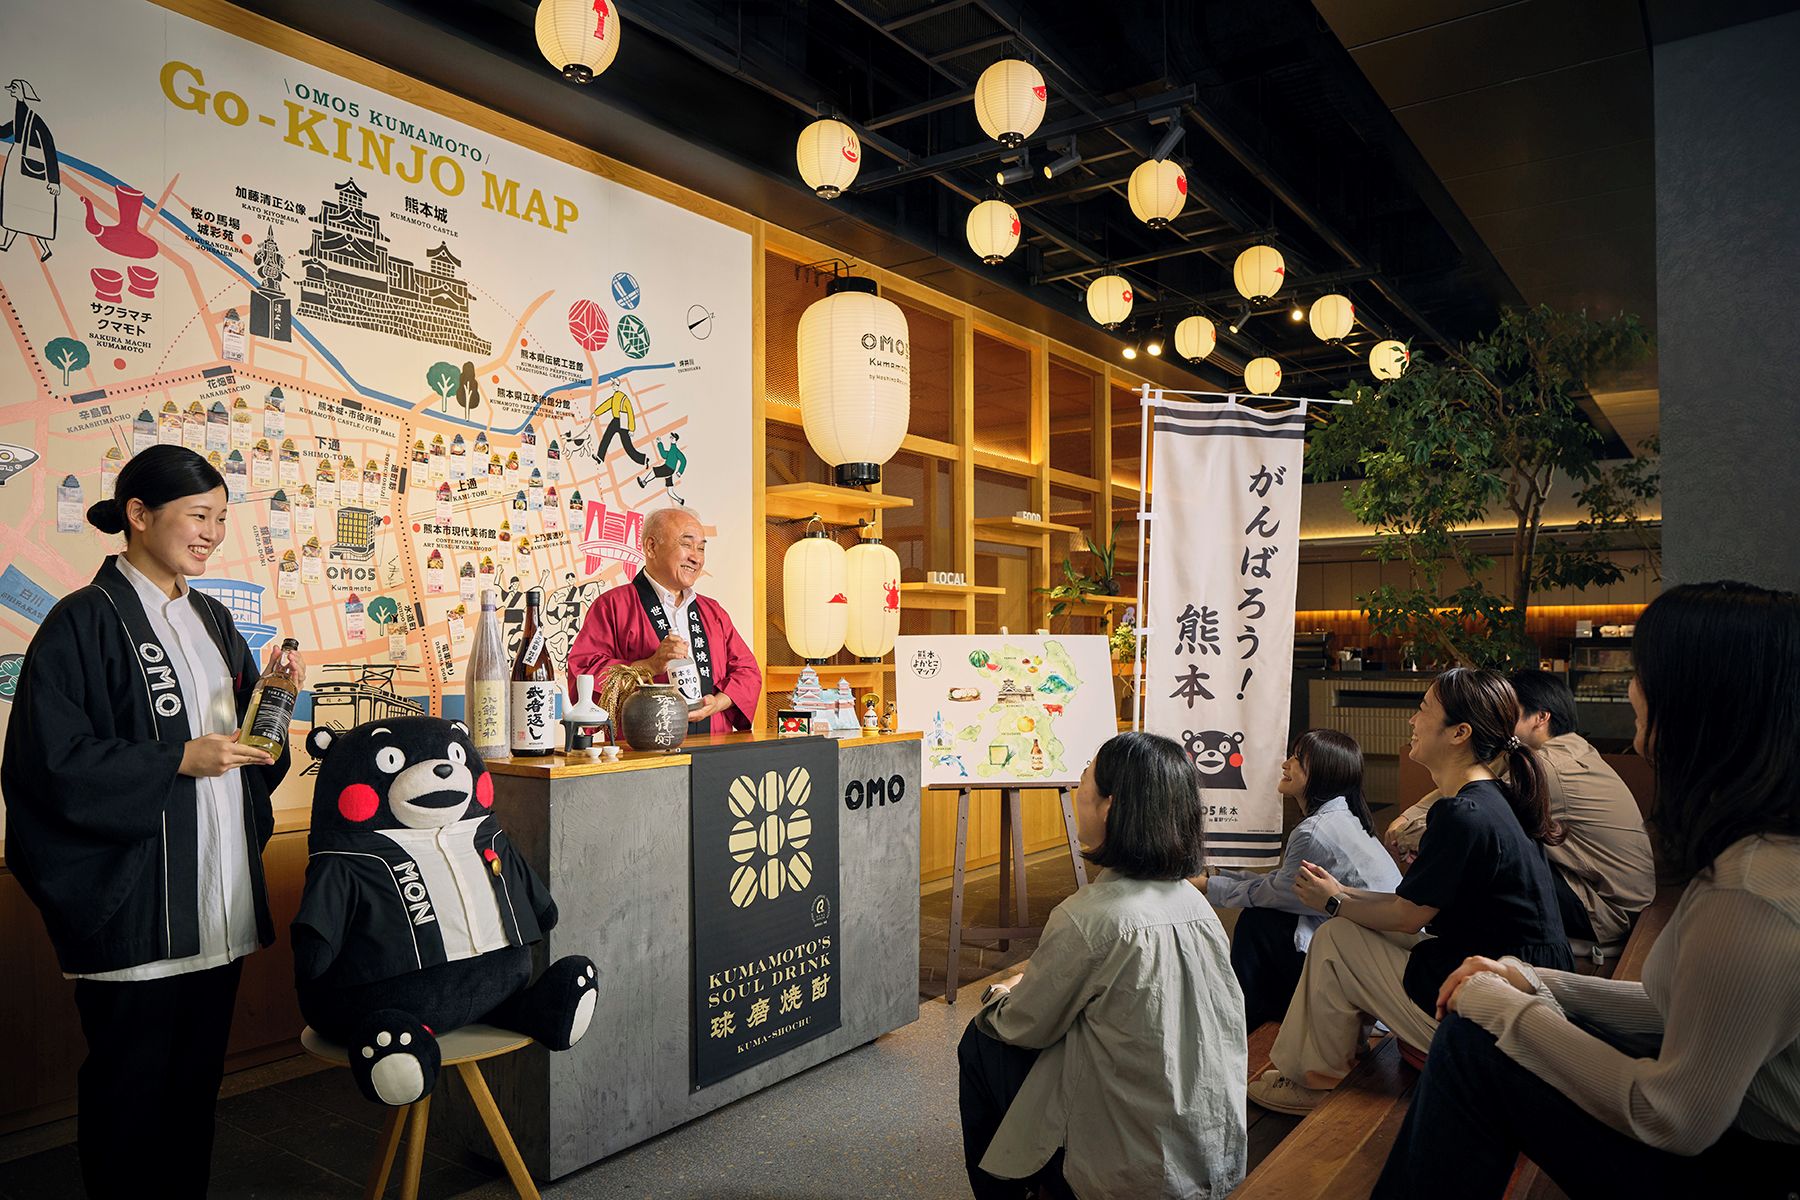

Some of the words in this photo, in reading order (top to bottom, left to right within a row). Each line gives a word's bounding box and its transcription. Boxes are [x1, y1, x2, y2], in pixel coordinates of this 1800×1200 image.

[295, 83, 360, 117] OMO5
[369, 109, 483, 163] KUMAMOTO
[235, 185, 307, 216] 加藤清正公像
[404, 195, 448, 224] 熊本城
[481, 170, 579, 234] MAP
[190, 206, 241, 231] 桜の馬場
[241, 203, 262, 213] KATO
[263, 209, 299, 224] KIYOMASA
[257, 214, 285, 226] STATUE
[197, 222, 235, 243] 城彩苑
[390, 211, 431, 229] KUMAMOTO
[433, 225, 459, 238] CASTLE
[90, 302, 153, 324] サクラマチ
[97, 318, 146, 337] クマモト
[89, 332, 123, 344] SAKURA
[125, 338, 152, 349] MACHI
[96, 341, 144, 354] KUMAMOTO
[520, 349, 584, 372] 熊本県伝統工芸館
[520, 362, 549, 372] KUMAMOTO
[549, 368, 582, 379] PREFECTURAL
[206, 375, 237, 390] 花畑町
[516, 365, 548, 377] TRADITIONAL
[549, 372, 568, 381] CRAFTS
[199, 384, 251, 401] HANABATACHO
[497, 387, 571, 410] 熊本県立美術館分館
[78, 404, 112, 421] 辛島町
[489, 399, 519, 408] KUMAMOTO
[66, 413, 131, 434] KARASHIMACHO
[299, 407, 336, 422] KUMAMOTO
[365, 425, 379, 434] CITY
[380, 429, 396, 438] HALL
[315, 435, 341, 452] 下通
[302, 449, 352, 461] SHIMO-TOR
[457, 477, 478, 492] 上通
[1022, 511, 1041, 522] FOOD
[423, 523, 497, 540] 熊本市現代美術館
[435, 537, 480, 546] CONTEMPORARY
[331, 584, 372, 592] Kumamoto
[934, 571, 967, 586] LOCAL
[1235, 464, 1286, 701] がんばろう!
[1, 591, 46, 619] SHIRAKAW
[20, 588, 45, 608] 白川
[404, 604, 417, 631] 水道町
[650, 605, 669, 636] 世界
[913, 659, 939, 668] よかとこ
[1168, 603, 1222, 710] 熊本
[139, 642, 182, 717] OMO
[916, 667, 938, 675] マップ
[525, 685, 545, 740] 武者返し
[845, 774, 905, 810] OMO
[393, 860, 436, 926] MON
[708, 935, 831, 989] KUMAMOTO'S
[708, 978, 765, 1008] SOUL
[771, 952, 831, 987] DRINK
[710, 972, 831, 1039] 球磨焼酎
[737, 1016, 812, 1054] KUMA-SHOCHU
